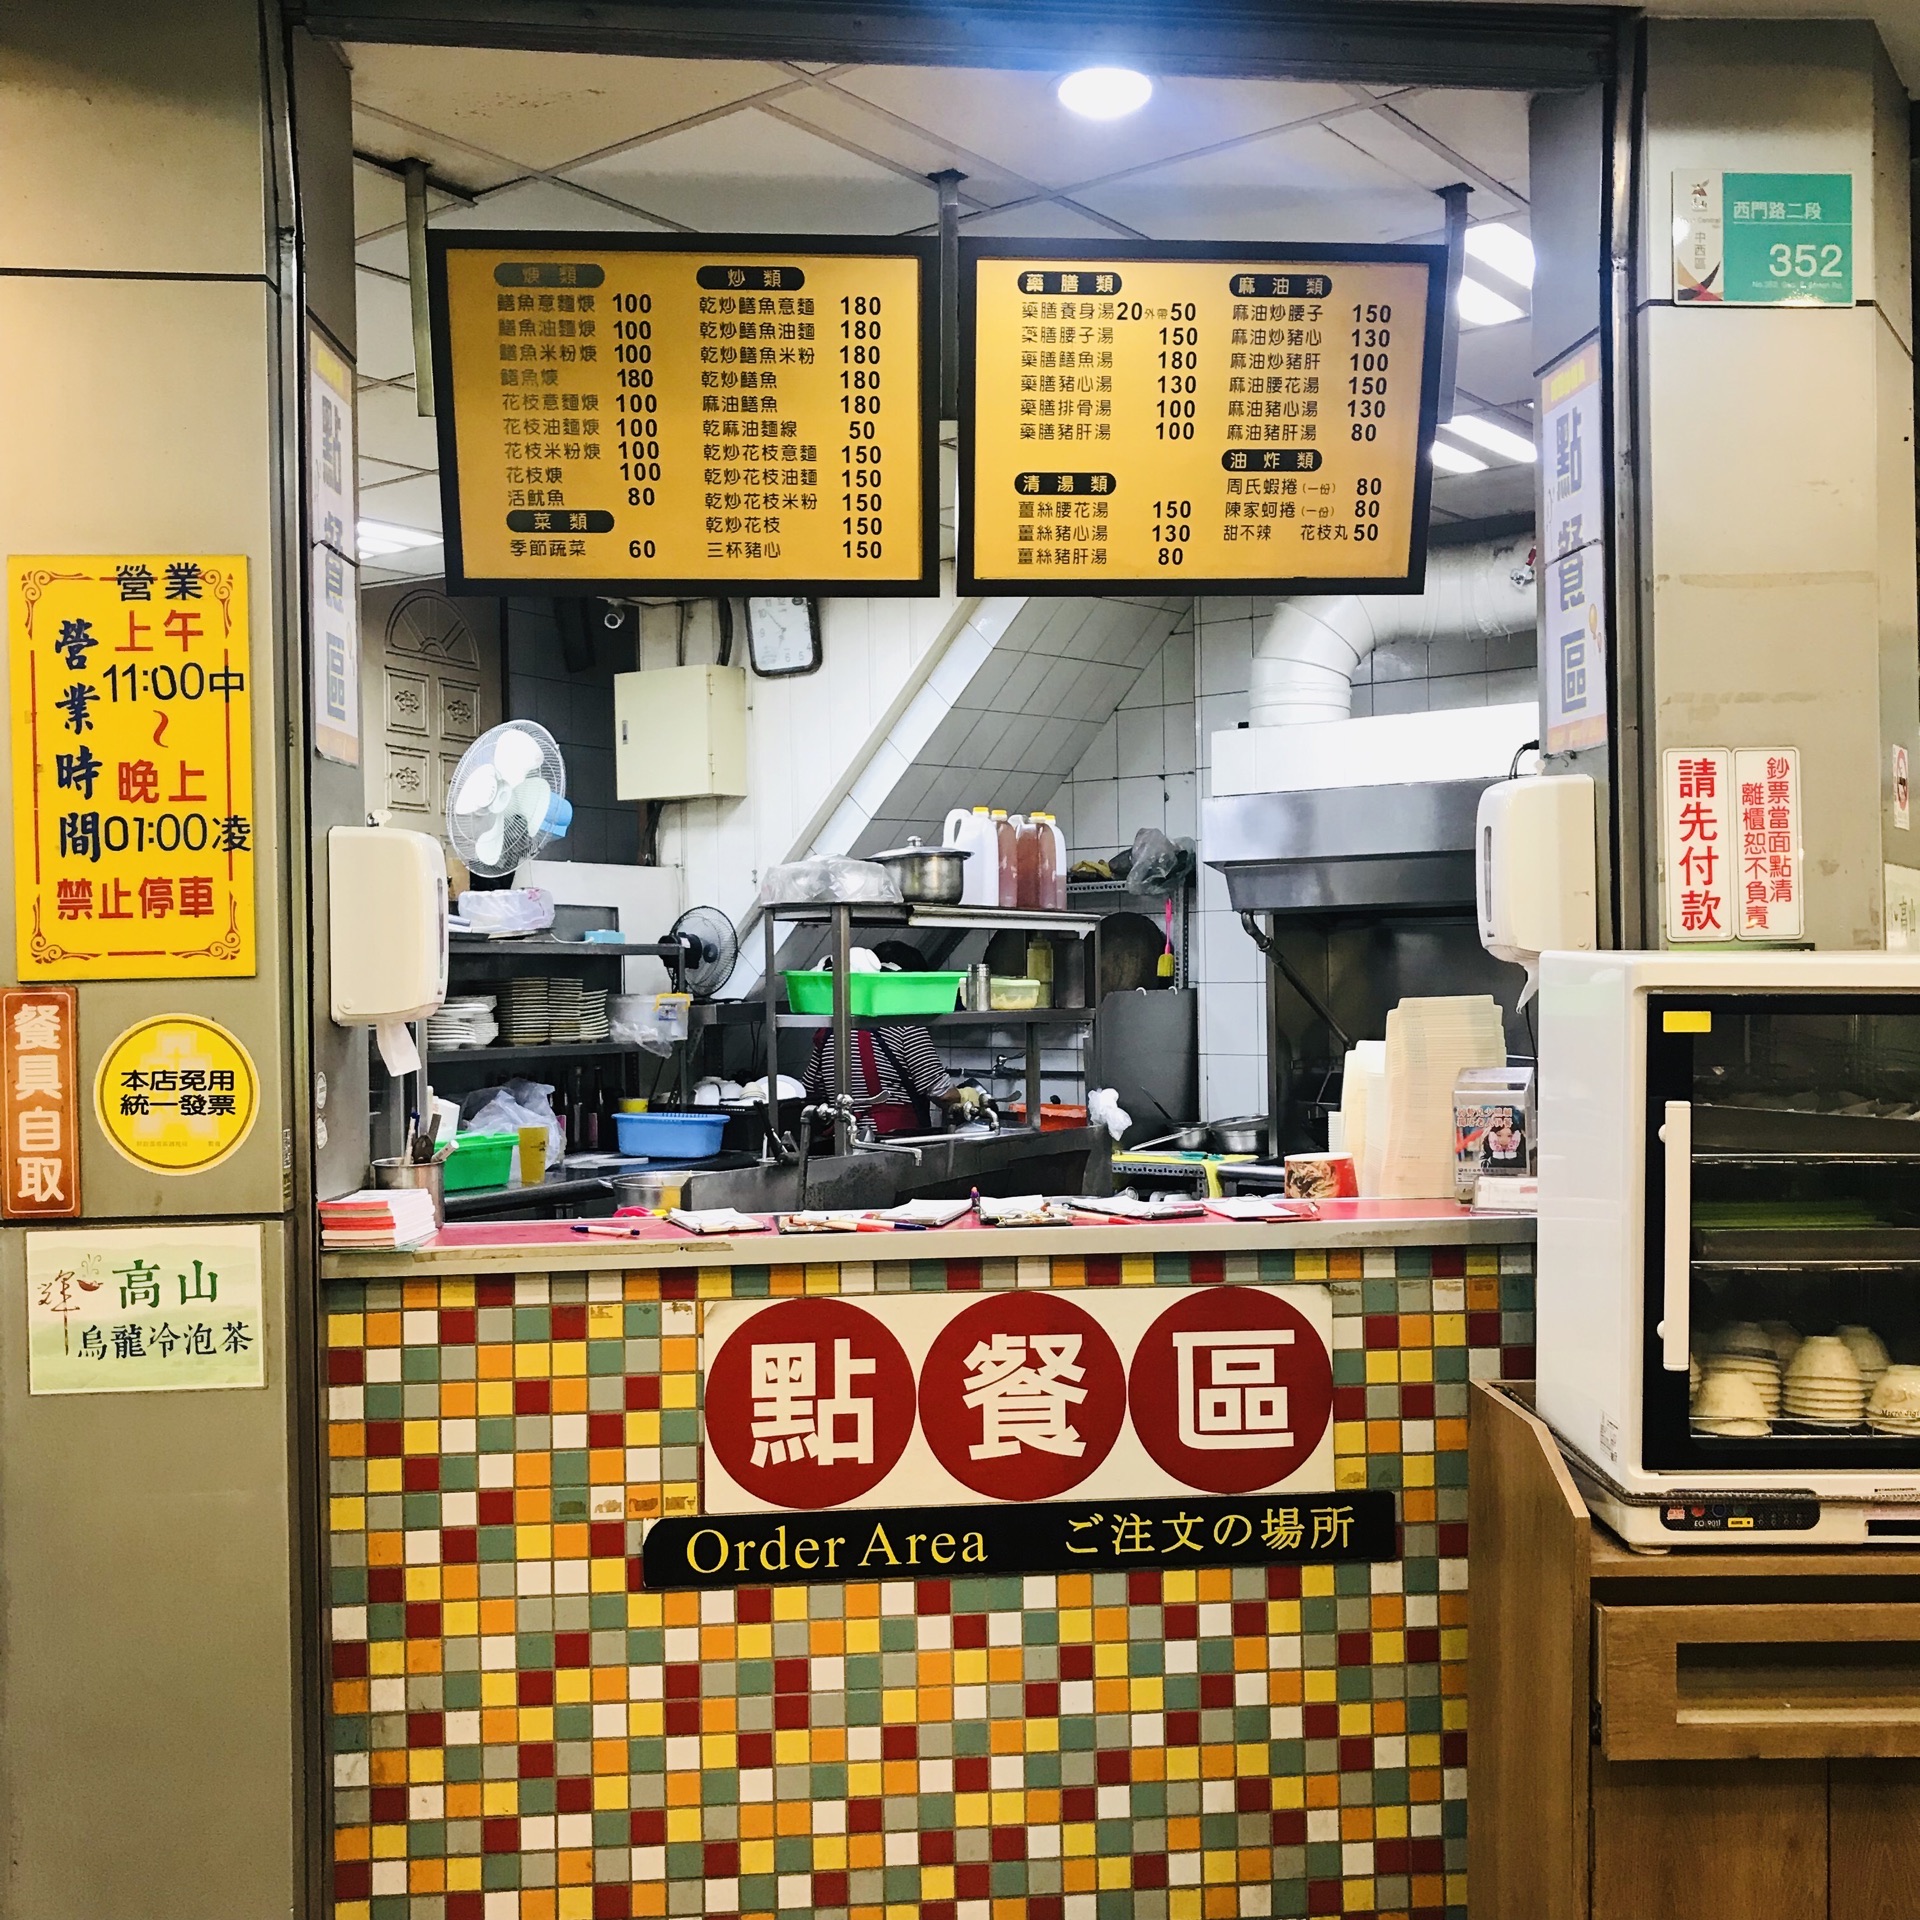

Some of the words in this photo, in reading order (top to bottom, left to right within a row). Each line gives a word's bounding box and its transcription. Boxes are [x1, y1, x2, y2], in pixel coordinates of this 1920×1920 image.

[1733, 201, 1822, 220] 西門路二段
[1769, 243, 1843, 278] 352
[727, 269, 782, 288] 炒類
[1026, 273, 1114, 293] 藥膳類
[1238, 276, 1324, 296] 麻油類
[613, 293, 652, 314] 100
[699, 297, 815, 316] 乾炒鱔魚意麵
[840, 296, 881, 316] 180
[1022, 301, 1115, 320] 藥膳養身湯
[1116, 302, 1143, 321] 20
[1170, 302, 1196, 322] 50
[1232, 304, 1324, 322] 麻油炒腰子
[1352, 304, 1392, 323] 150
[613, 320, 652, 340] 100
[700, 321, 815, 340] 乾炒鱔魚油麵
[840, 320, 881, 340] 180
[1021, 326, 1114, 345] 藥膳腰子湯
[1159, 327, 1198, 346] 150
[1231, 328, 1322, 346] 麻油炒豬心
[1351, 328, 1391, 347] 130
[614, 344, 652, 364] 100
[700, 346, 815, 365] 乾炒鱔魚米粉
[840, 345, 881, 365] 180
[1021, 350, 1113, 369] 藥膳鱔魚湯
[1158, 350, 1197, 370] 180
[1230, 352, 1321, 370] 麻油炒豬肝
[1350, 353, 1389, 371] 100
[616, 369, 654, 388] 180
[701, 370, 778, 389] 乾炒鱔魚
[840, 370, 881, 389] 180
[1020, 374, 1112, 393] 藥膳豬心湯
[1157, 375, 1197, 394] 130
[1229, 376, 1319, 394] 麻油腰花湯
[1348, 376, 1387, 395] 150
[615, 394, 658, 413] 100
[702, 395, 778, 413] 麻油鱔魚
[840, 395, 881, 414] 180
[1020, 398, 1112, 417] 藥膳排骨湯
[1156, 400, 1196, 418] 100
[1228, 400, 1318, 417] 麻油豬心湯
[1347, 400, 1386, 418] 130
[616, 418, 658, 438] 100
[702, 419, 798, 438] 乾麻油麵線
[849, 421, 876, 440] 50
[1020, 422, 1111, 441] 藥膳豬肝湯
[1155, 422, 1195, 440] 100
[1226, 424, 1317, 441] 麻油豬肝湯
[1351, 423, 1377, 442] 80
[618, 441, 660, 460] 100
[703, 444, 817, 462] 乾炒花枝意麵
[841, 445, 882, 464] 150
[1230, 452, 1314, 469] 油炸類
[619, 462, 661, 482] 100
[704, 468, 818, 486] 乾炒花枝油麵
[841, 469, 882, 488] 150
[1023, 475, 1108, 493] 清湯類
[1226, 478, 1298, 496] 周氏蝦捲
[1356, 477, 1382, 496] 80
[507, 489, 565, 507] 活魷魚
[628, 487, 656, 506] 80
[704, 493, 818, 510] 乾炒花枝米粉
[842, 493, 882, 512] 150
[1018, 501, 1109, 519] 薑絲腰花湯
[1152, 500, 1192, 519] 150
[1225, 501, 1296, 518] 陳家蚵捲
[1354, 500, 1380, 519] 80
[534, 512, 588, 531] 菜類
[705, 516, 781, 534] 乾炒花枝
[842, 517, 882, 536] 150
[1018, 524, 1108, 542] 薑絲豬心湯
[1152, 524, 1191, 543] 130
[1223, 524, 1272, 542] 甜不辣
[1300, 524, 1348, 541] 花枝丸
[1353, 523, 1379, 542] 50
[510, 539, 587, 557] 季節蔬菜
[629, 540, 656, 559] 60
[707, 542, 781, 559] 三杯豬心
[842, 541, 882, 559] 150
[1017, 548, 1107, 565] 薑絲豬肝湯
[1158, 547, 1184, 566] 80
[116, 562, 203, 602] 營業
[115, 609, 204, 652] 上午
[55, 618, 103, 863] 營業時間
[118, 759, 207, 804] 晚上
[1766, 756, 1793, 903] 鈔票當面點清
[1678, 757, 1722, 931] 請先付款
[1741, 782, 1769, 929] 離櫃恕不負責
[57, 876, 215, 921] 禁止停車
[120, 1069, 235, 1092] 本店免用
[14, 1003, 65, 1203] 餐具自取
[119, 1094, 236, 1116] 統一發票
[112, 1258, 219, 1309] 高山
[78, 1321, 254, 1361] 烏龍冷泡茶
[749, 1329, 1296, 1469] 點餐區
[1065, 1505, 1355, 1556] ご注文の場所
[686, 1525, 846, 1574] Order
[858, 1522, 989, 1567] Area
